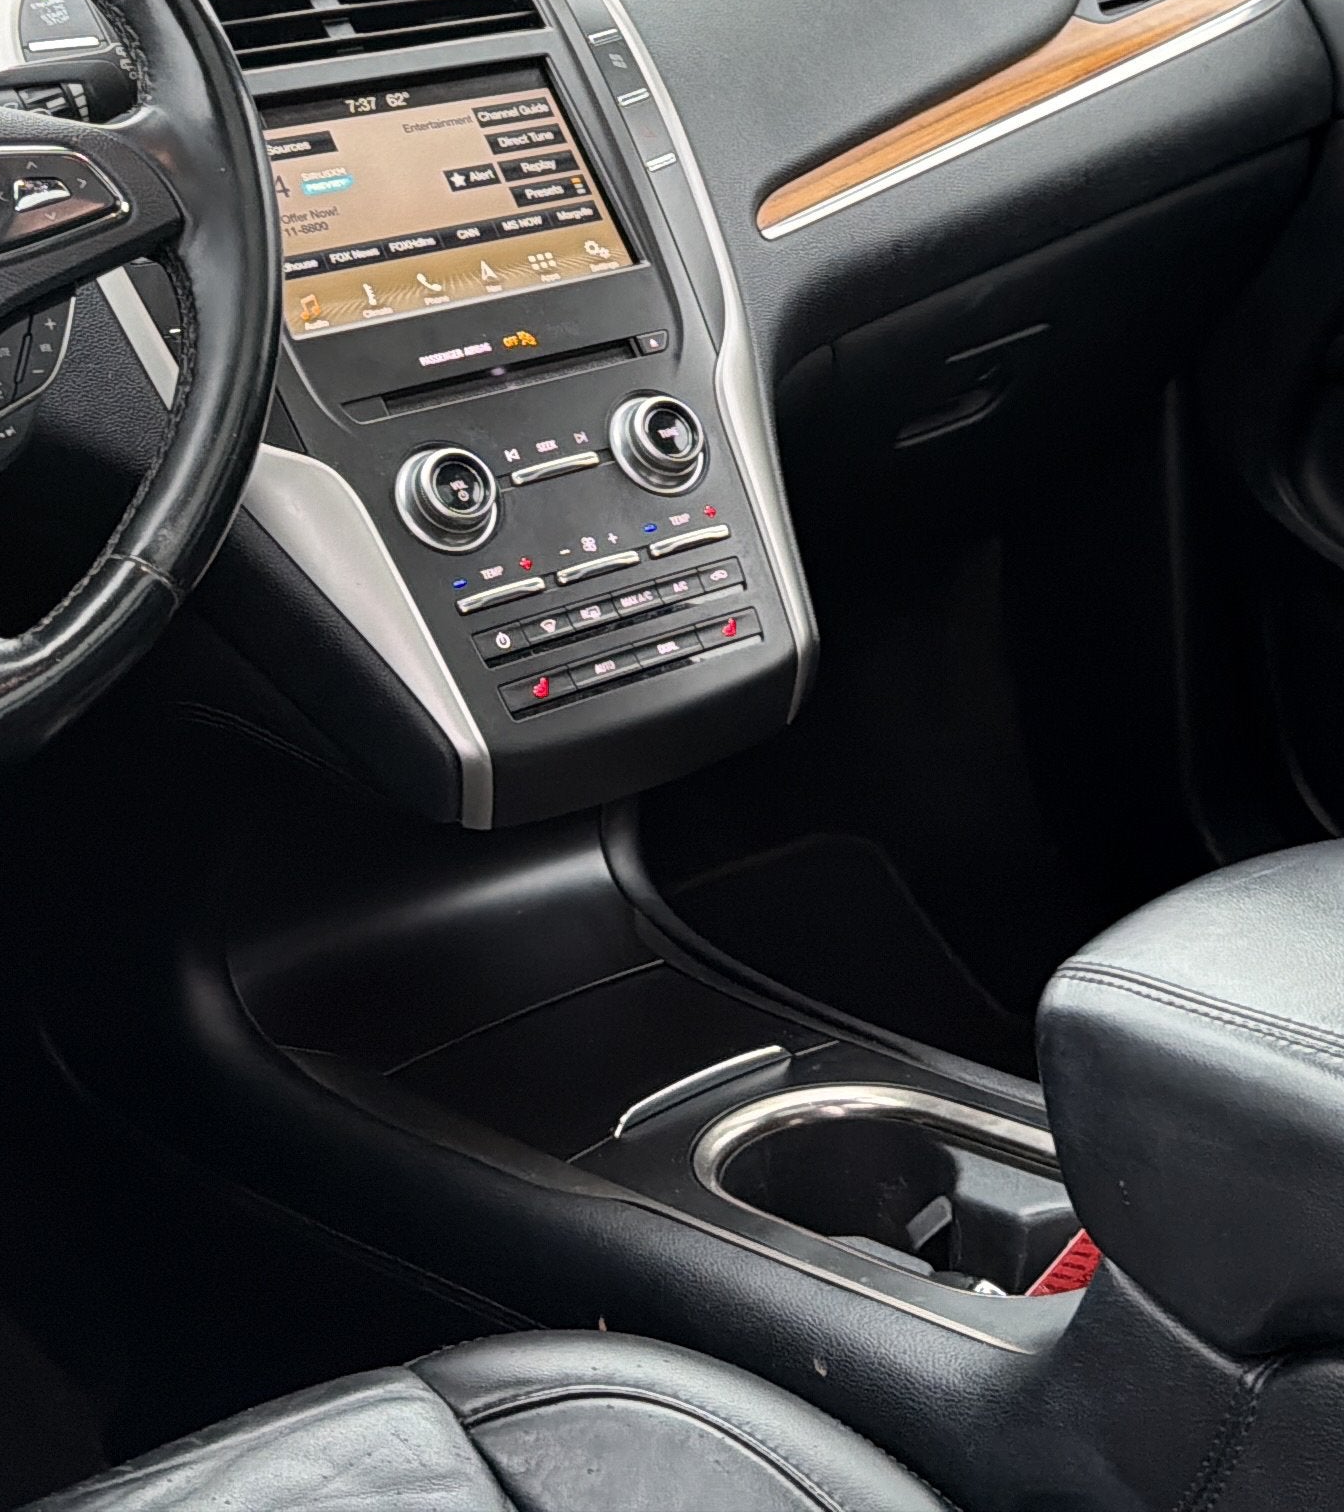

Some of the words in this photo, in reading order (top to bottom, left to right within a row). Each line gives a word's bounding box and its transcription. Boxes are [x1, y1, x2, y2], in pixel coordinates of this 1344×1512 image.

[344, 96, 377, 113] 7:37
[477, 106, 519, 122] Channel
[519, 102, 550, 117] Guide
[402, 115, 473, 133] Entertainment
[497, 133, 529, 148] Direct
[530, 130, 555, 144] Tune
[267, 141, 312, 156] Sources
[520, 159, 557, 174] Replay
[469, 168, 495, 183] Alert
[524, 184, 565, 200] Presets
[281, 213, 308, 225] Offer
[309, 206, 340, 220] Now!
[501, 219, 519, 232] MS
[518, 216, 543, 229] NOW
[456, 227, 481, 240] CNN
[329, 250, 354, 265] FOX
[352, 247, 381, 260] News
[668, 512, 691, 526] TEMP
[479, 565, 504, 580] TEMP
[594, 660, 616, 675] AUTO
